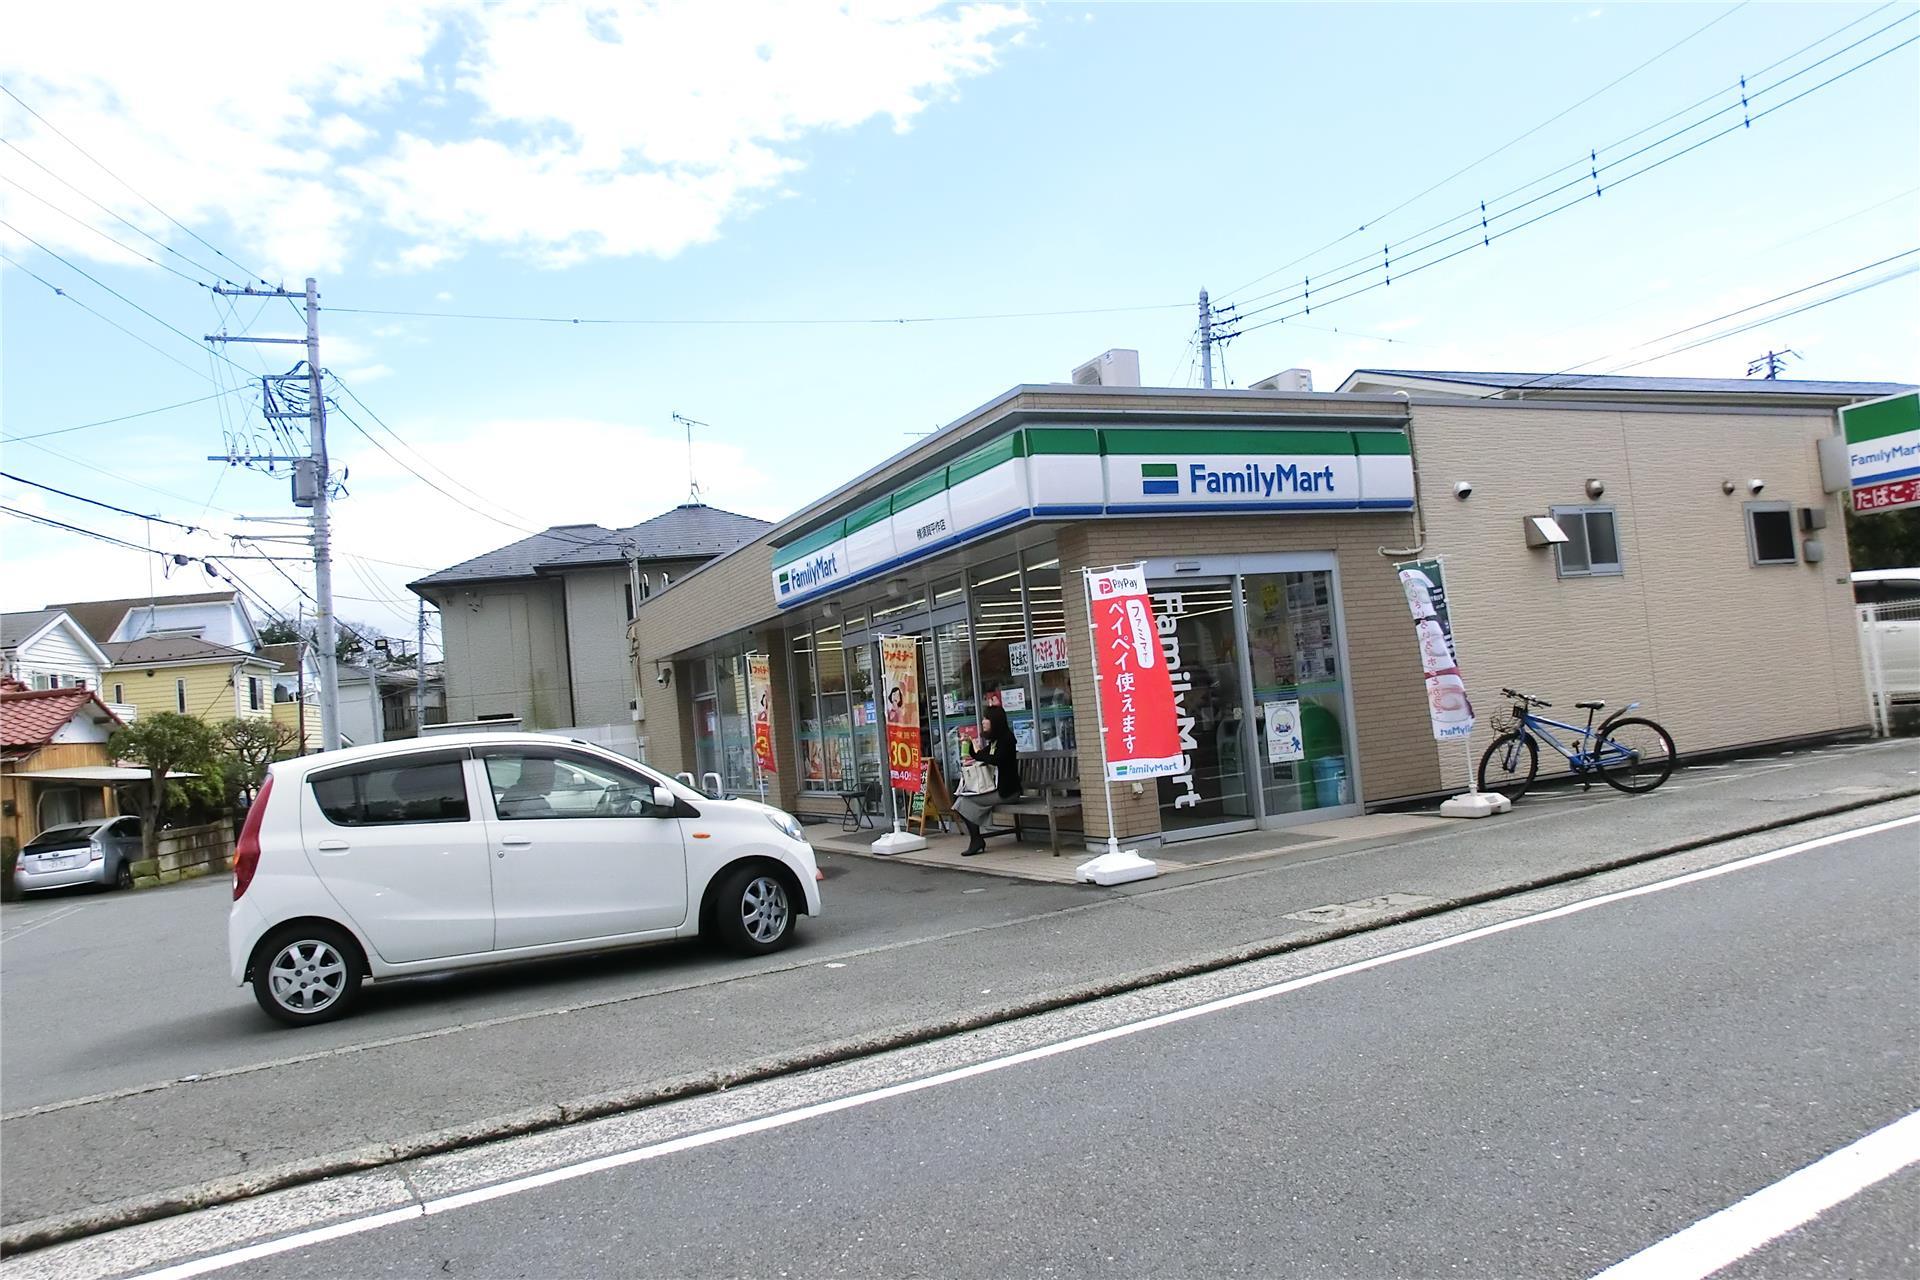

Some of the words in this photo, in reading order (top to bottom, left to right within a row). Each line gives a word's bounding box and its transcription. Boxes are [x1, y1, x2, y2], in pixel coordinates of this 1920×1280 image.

[1851, 443, 1920, 467] FamilyMart
[1189, 463, 1335, 497] FamilyMart
[916, 519, 946, 541] 横須賀平作店
[791, 553, 838, 591] FamilyMart
[1112, 578, 1138, 590] PayPay
[1108, 601, 1136, 754] ペイペイ使えます
[1129, 763, 1178, 774] FamilyMart
